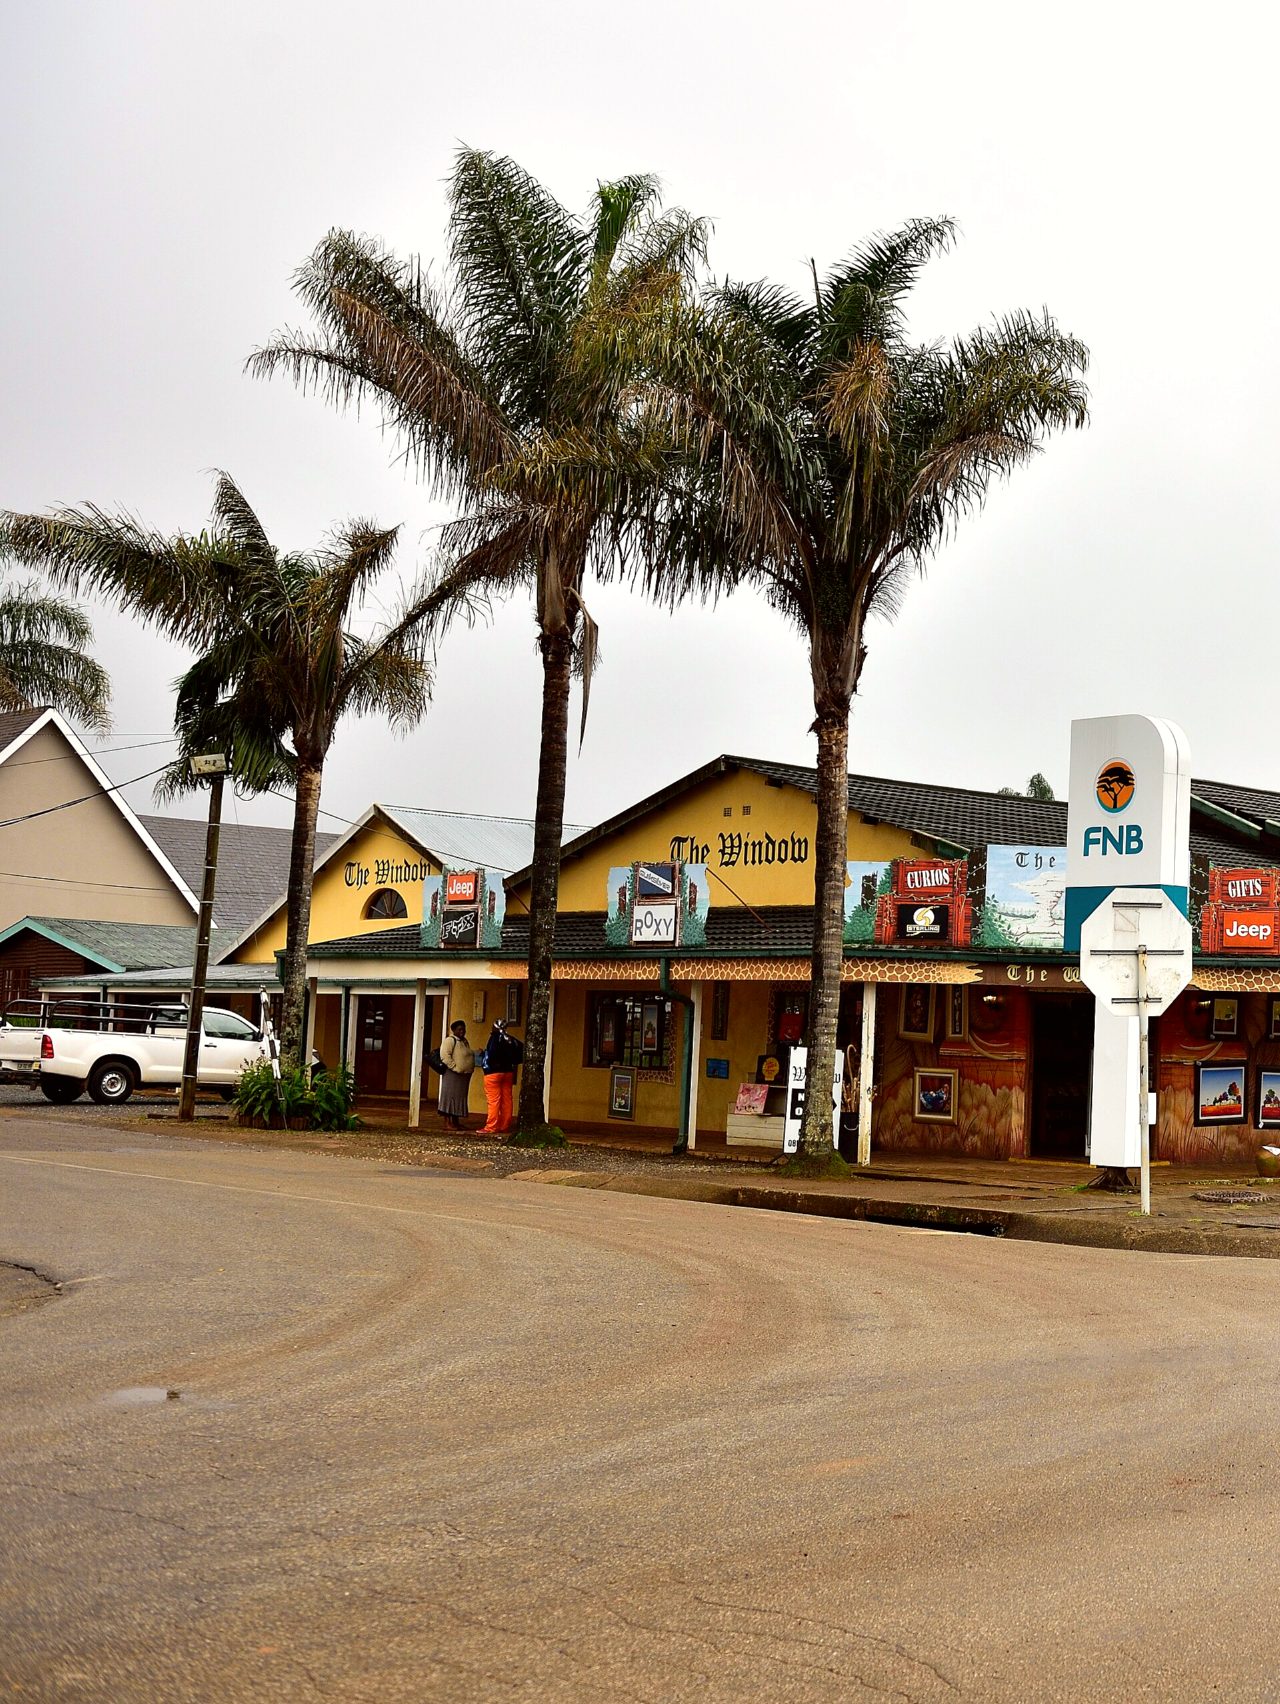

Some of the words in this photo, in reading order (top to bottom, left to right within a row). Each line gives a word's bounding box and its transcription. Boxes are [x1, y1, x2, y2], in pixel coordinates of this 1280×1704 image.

[669, 835, 710, 864] The
[718, 831, 809, 867] Window
[1083, 824, 1144, 857] FNB
[1015, 852, 1056, 870] The
[344, 862, 369, 890] The
[375, 858, 431, 885] Window
[907, 868, 950, 888] CURIOS
[450, 879, 473, 897] Jeep
[1228, 878, 1262, 898] GIFTS
[634, 911, 672, 936] ROXY
[1226, 920, 1271, 940] Jeep
[1006, 965, 1048, 984] The
